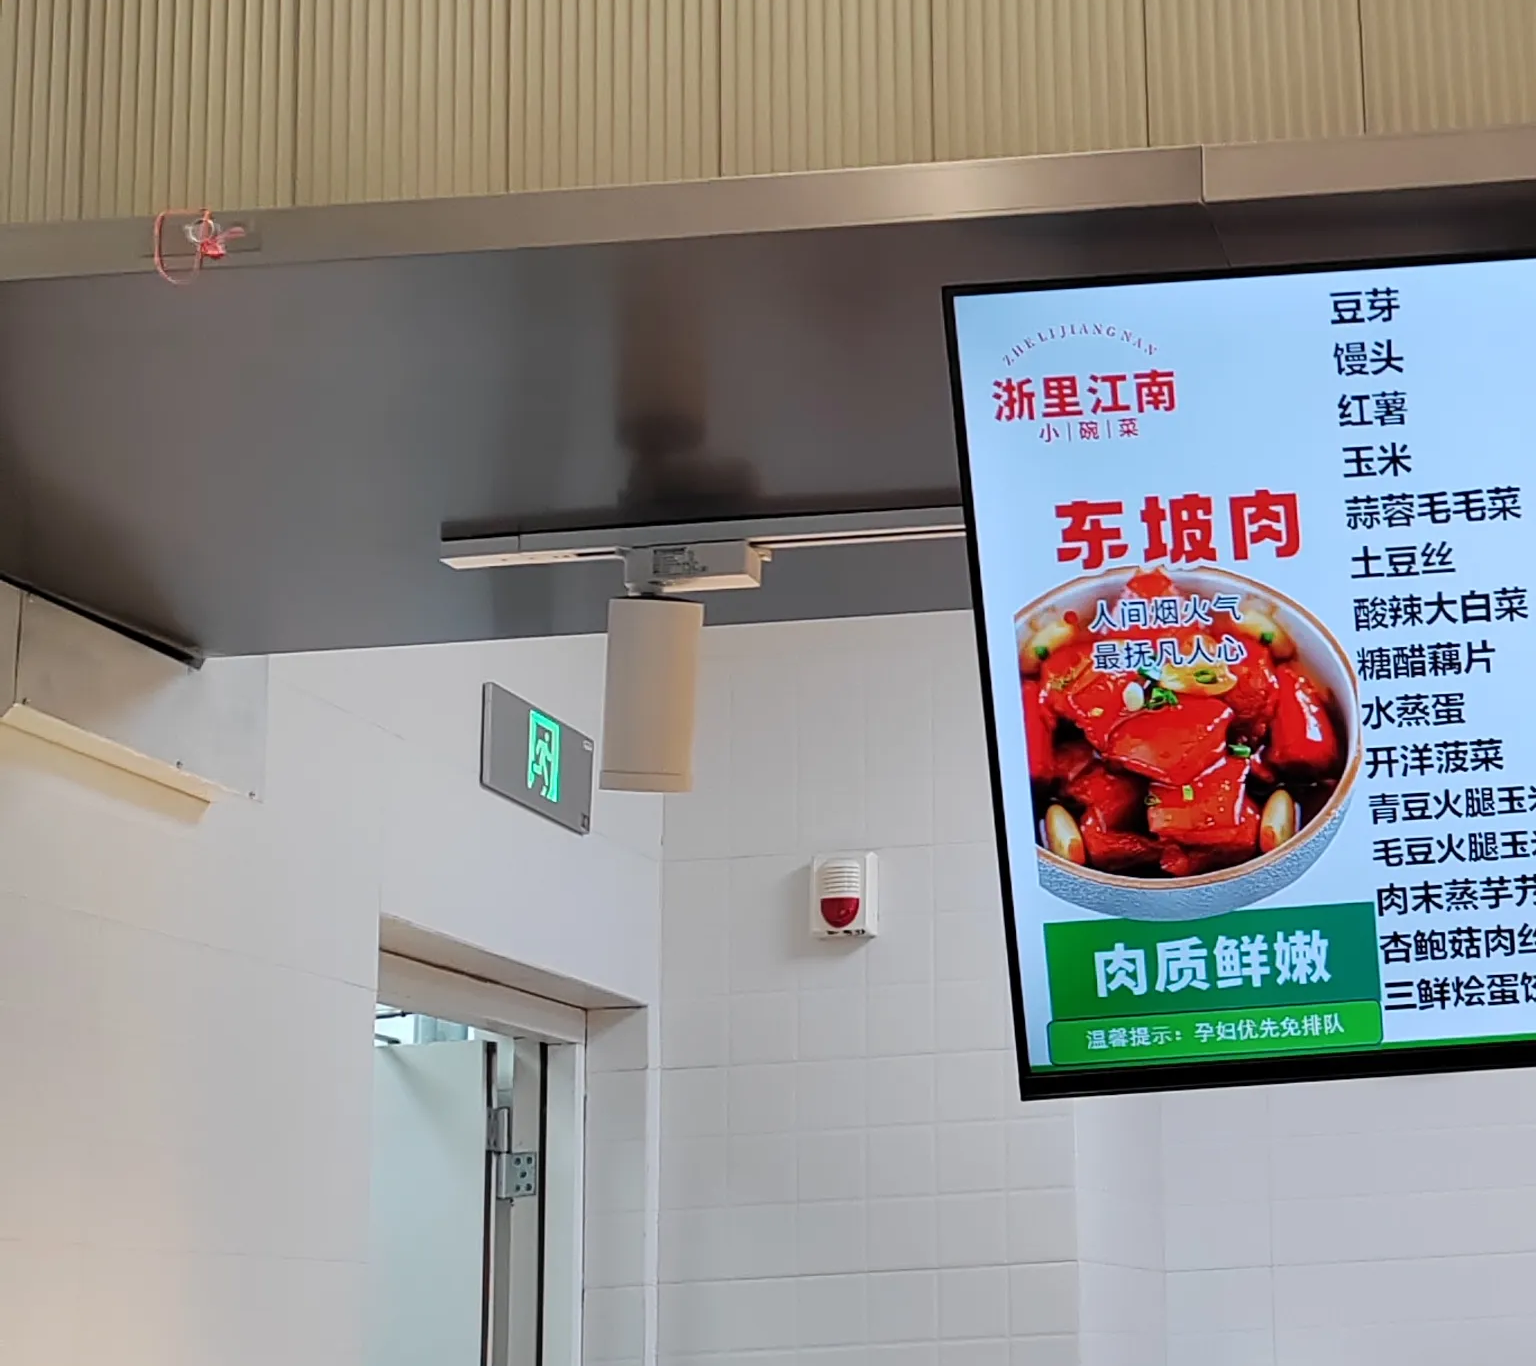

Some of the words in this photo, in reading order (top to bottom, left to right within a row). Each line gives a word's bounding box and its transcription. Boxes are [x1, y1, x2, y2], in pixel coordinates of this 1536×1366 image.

[1331, 288, 1400, 324] 豆芽
[1334, 340, 1403, 376] 馒头
[992, 369, 1177, 422] 浙里江南
[1338, 391, 1406, 426] 红薯
[1343, 443, 1411, 477] 玉米
[1345, 486, 1521, 529] 蒜蓉毛毛菜
[1055, 490, 1301, 569] 东坡肉
[1352, 542, 1455, 578] 土豆丝
[1090, 596, 1242, 630] 人间烟火气
[1354, 587, 1528, 631] 酸辣大白菜
[1094, 637, 1246, 669] 最抚凡人心
[1357, 640, 1495, 680] 糖醋藕片
[1362, 693, 1465, 729] 水蒸蛋
[1366, 738, 1503, 778] 开洋菠菜
[1094, 930, 1331, 998] 肉质鲜嫩
